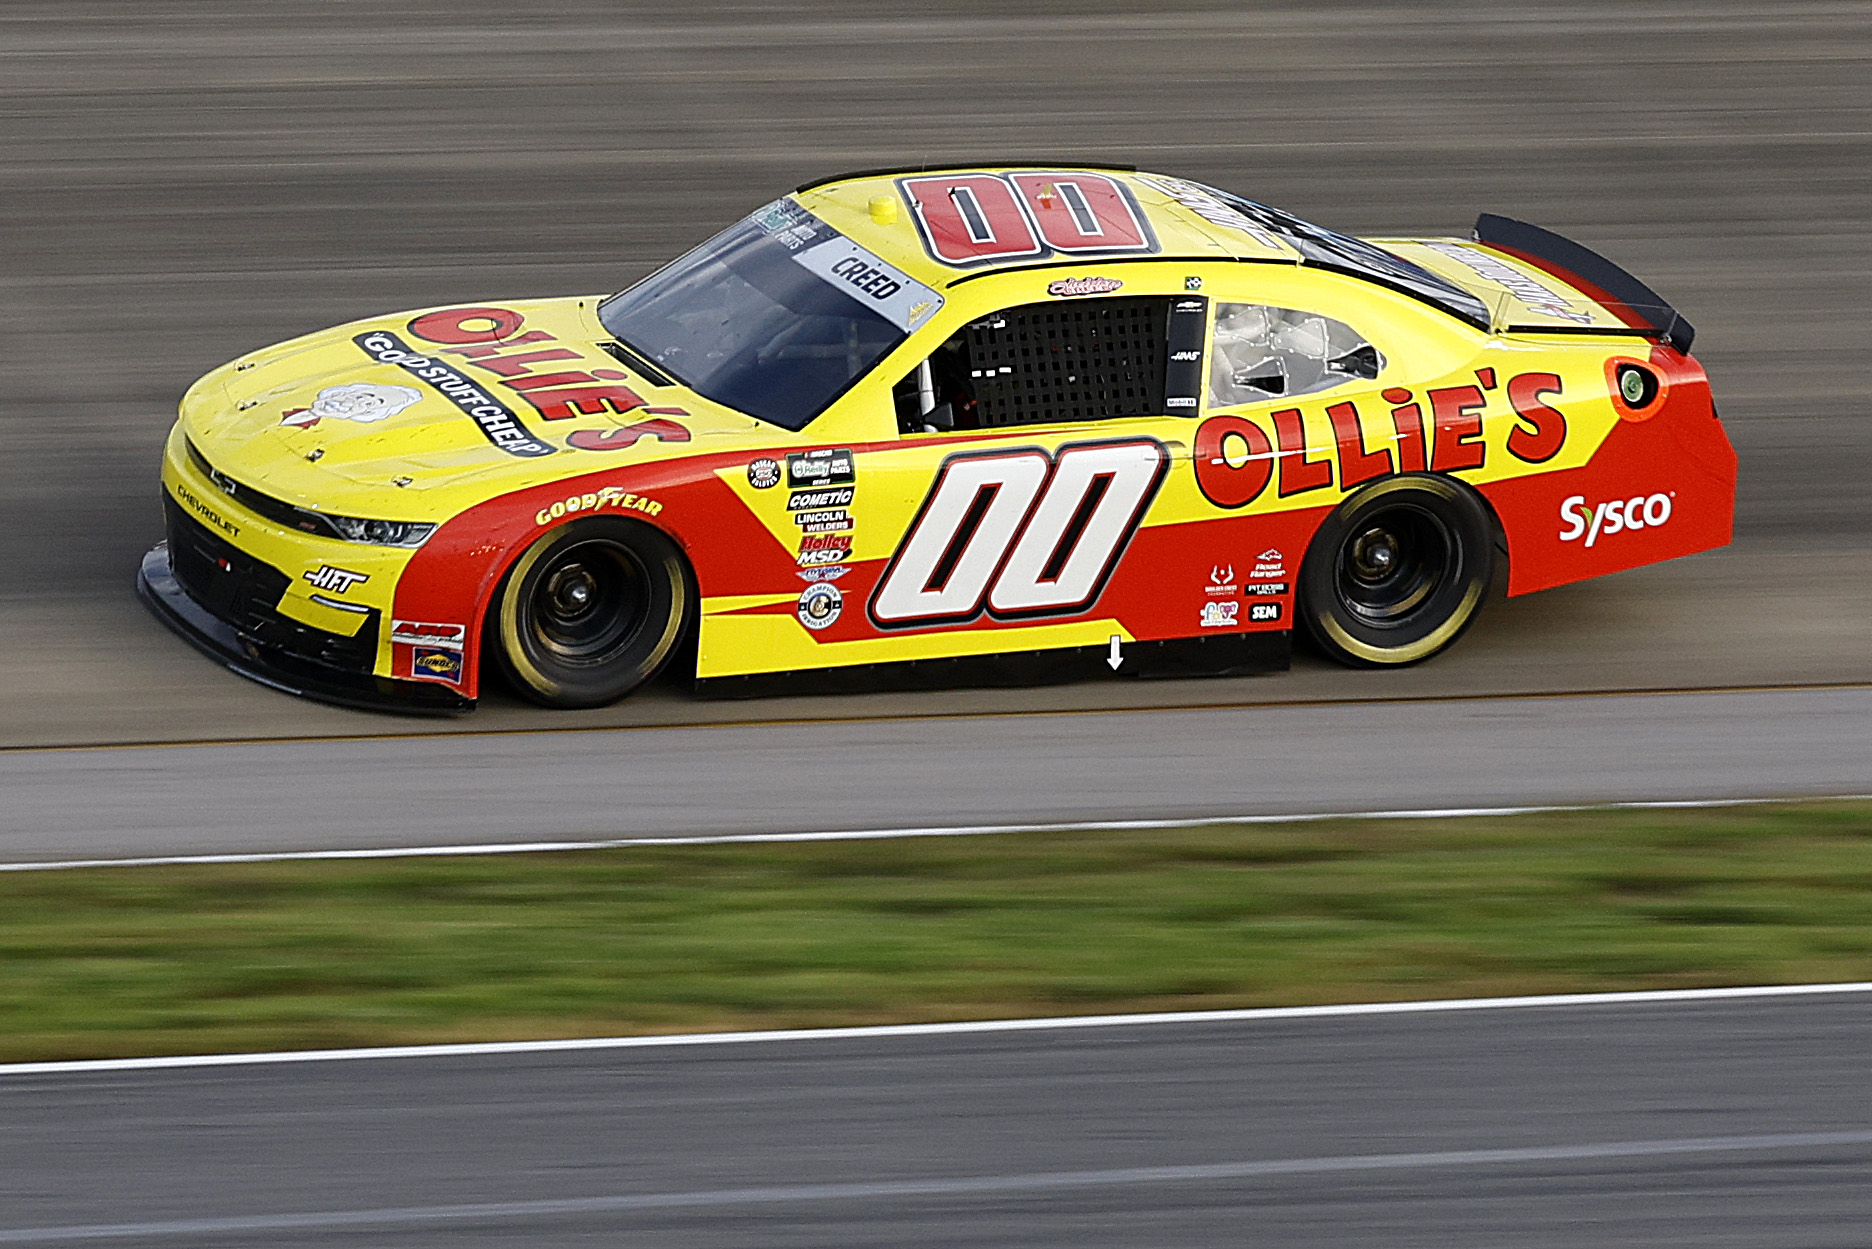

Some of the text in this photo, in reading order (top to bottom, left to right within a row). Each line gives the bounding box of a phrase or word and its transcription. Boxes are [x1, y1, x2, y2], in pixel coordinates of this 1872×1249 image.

[898, 172, 1158, 267] 00
[831, 257, 901, 300] CREED
[418, 358, 483, 409] STUFF
[177, 484, 241, 538] CHEVROLET
[535, 486, 663, 525] GOODYEAR
[790, 489, 852, 507] COMETIC
[797, 511, 844, 523] LINCOLN
[806, 521, 849, 532] WELDERS
[870, 440, 1168, 626] 00
[797, 549, 844, 565] MSD
[1252, 605, 1277, 619] SEM
